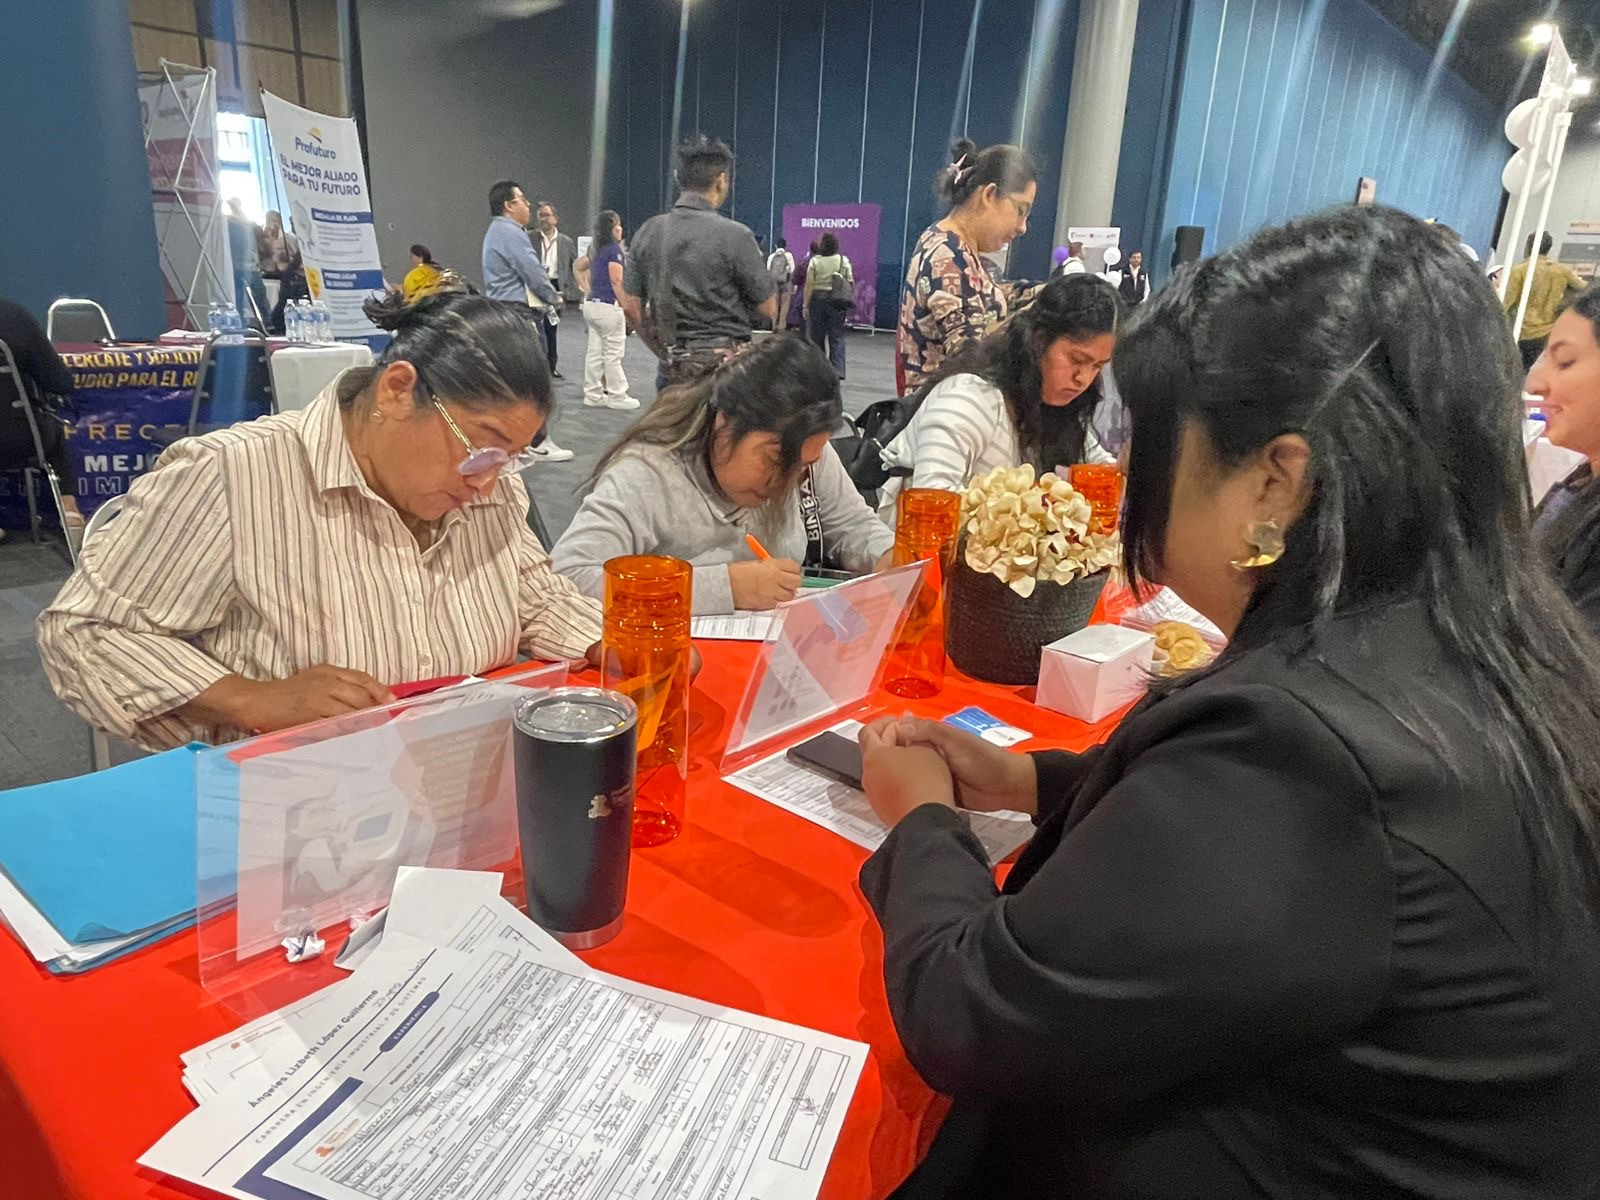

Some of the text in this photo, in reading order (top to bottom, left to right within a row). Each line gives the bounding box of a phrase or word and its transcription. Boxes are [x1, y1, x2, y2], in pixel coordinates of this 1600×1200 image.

[295, 137, 336, 159] Profuturo
[280, 154, 358, 182] EL MEJOR ALIADO
[307, 178, 319, 192] TU
[321, 183, 361, 195] FUTURO
[801, 217, 860, 228] BIENVENIDOS
[63, 352, 132, 368] CERCATE
[116, 371, 157, 388] PARA
[160, 370, 179, 387] EL
[64, 423, 180, 440] FREC
[78, 476, 135, 496] IM
[283, 1043, 320, 1077] Lizbeth
[316, 1023, 343, 1047] López
[340, 987, 379, 1025] Guillermo
